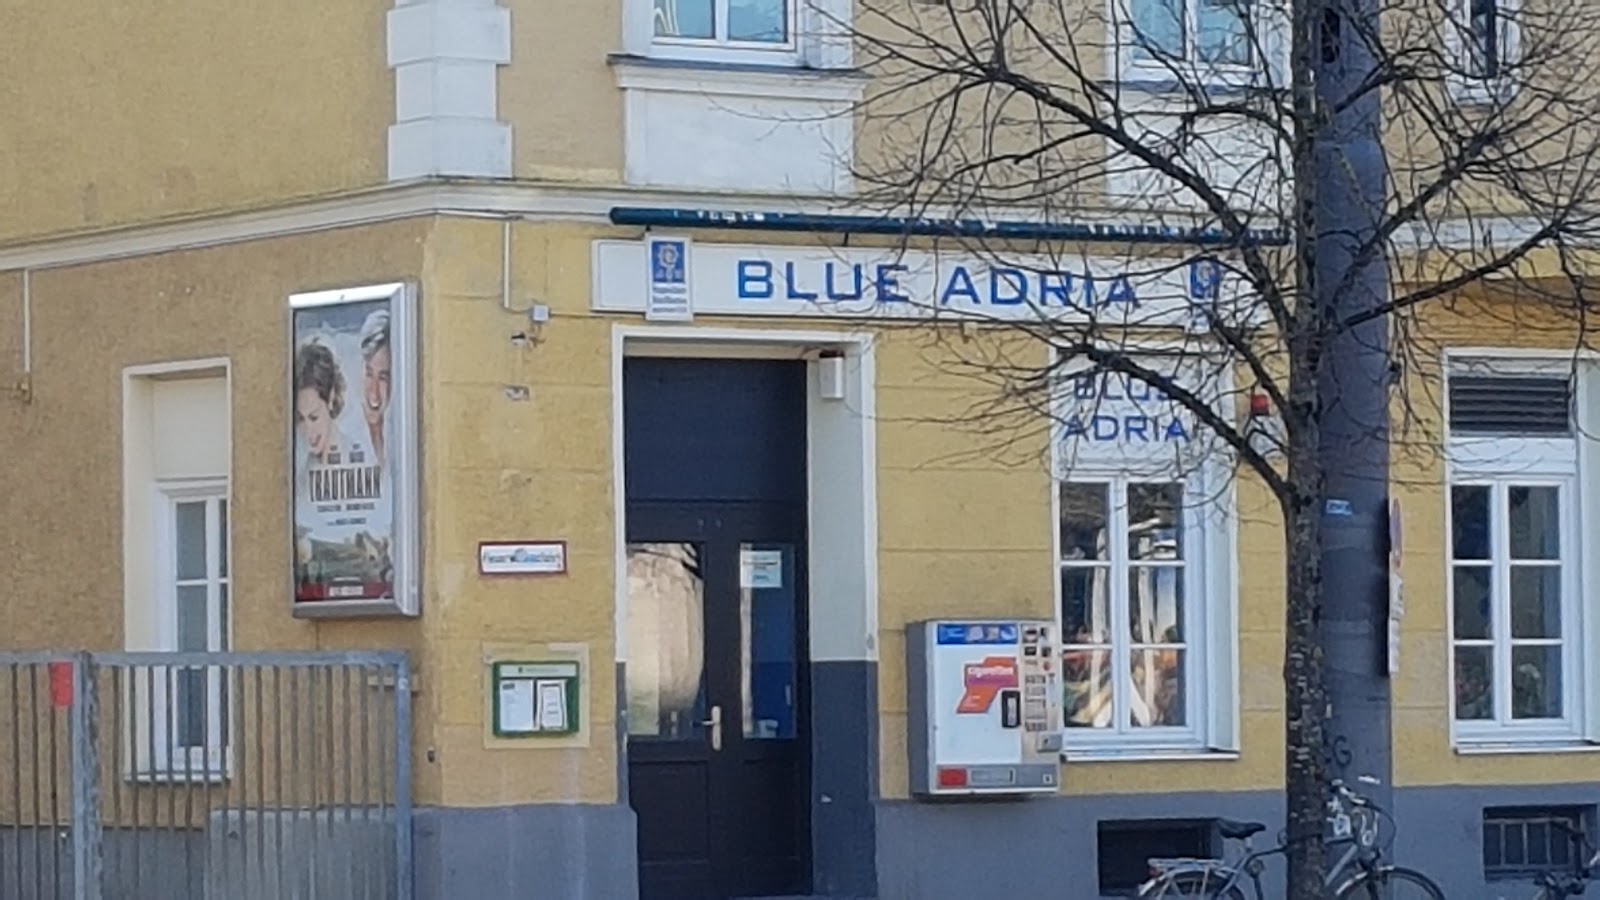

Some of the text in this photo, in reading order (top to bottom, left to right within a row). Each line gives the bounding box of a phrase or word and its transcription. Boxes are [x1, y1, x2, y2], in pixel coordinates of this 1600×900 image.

[737, 259, 1142, 308] BLUE ADRIA
[1063, 414, 1191, 442] ADRIA
[309, 466, 381, 502] TRAUTMANN
